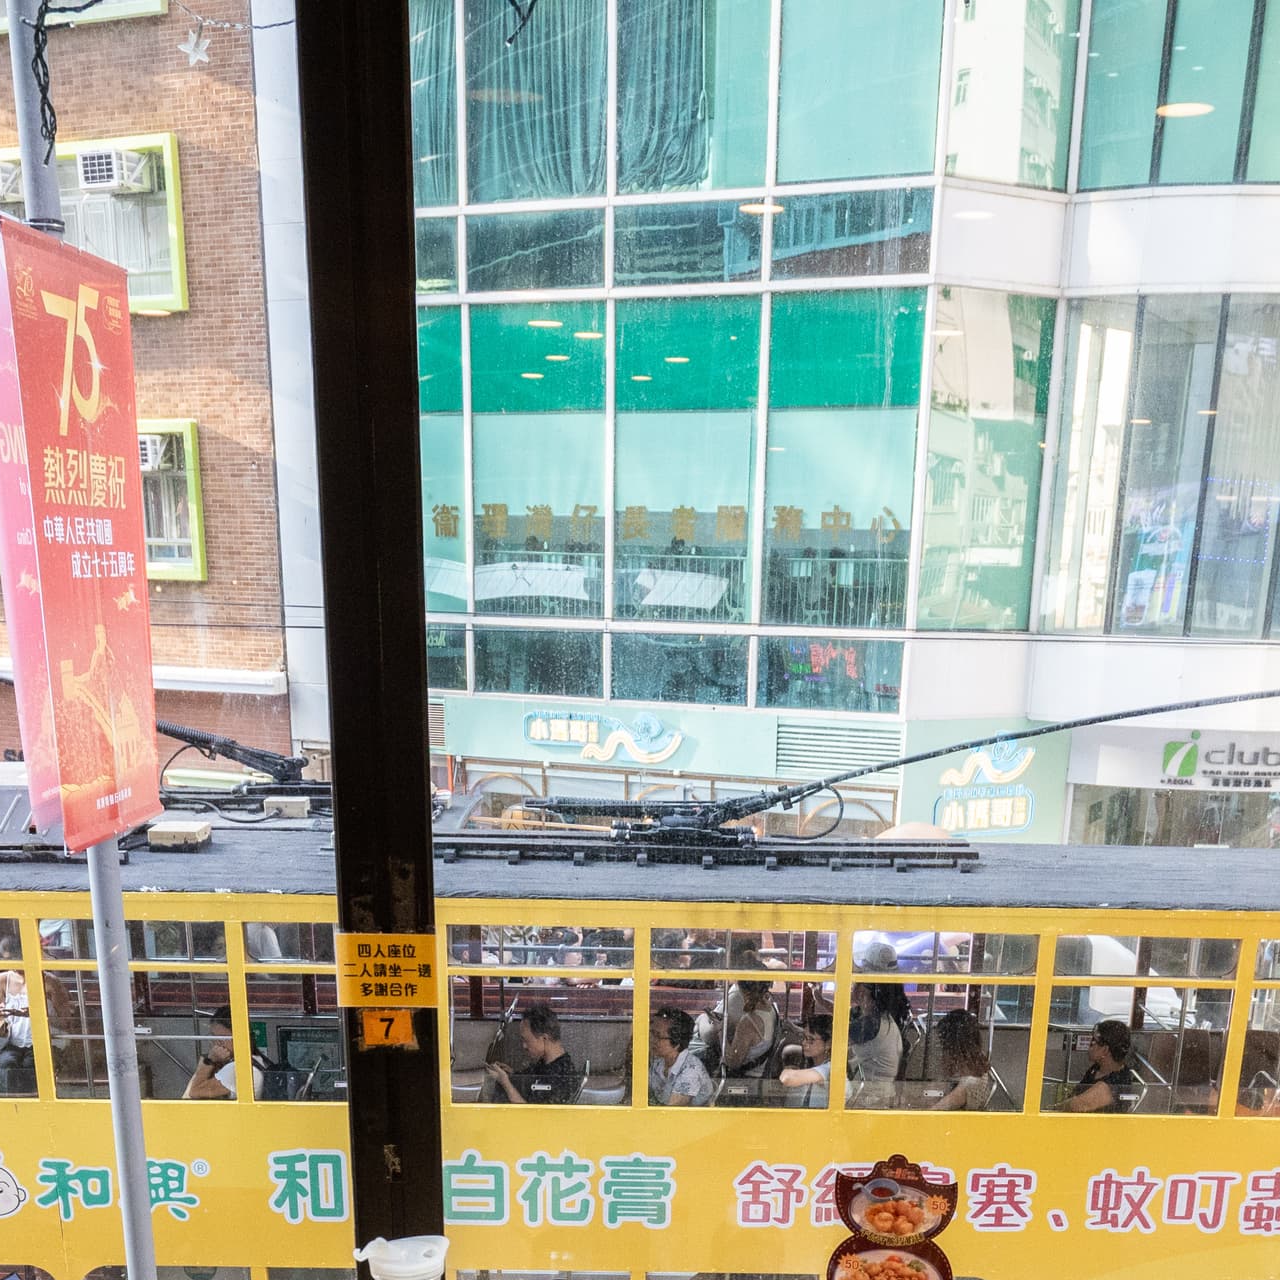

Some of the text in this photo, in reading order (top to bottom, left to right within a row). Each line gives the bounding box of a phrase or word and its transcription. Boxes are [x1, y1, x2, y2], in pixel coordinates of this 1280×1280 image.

[40, 284, 99, 437] 75
[43, 446, 126, 509] 熱烈慶祝
[43, 515, 113, 545] 中華人民共和國
[358, 944, 417, 958] 四人座位
[344, 963, 432, 978] 二人請坐一邊
[360, 982, 418, 997] 多謝合作
[379, 1018, 395, 1040] 7
[931, 1200, 947, 1211] 50
[844, 1259, 859, 1270] 50
